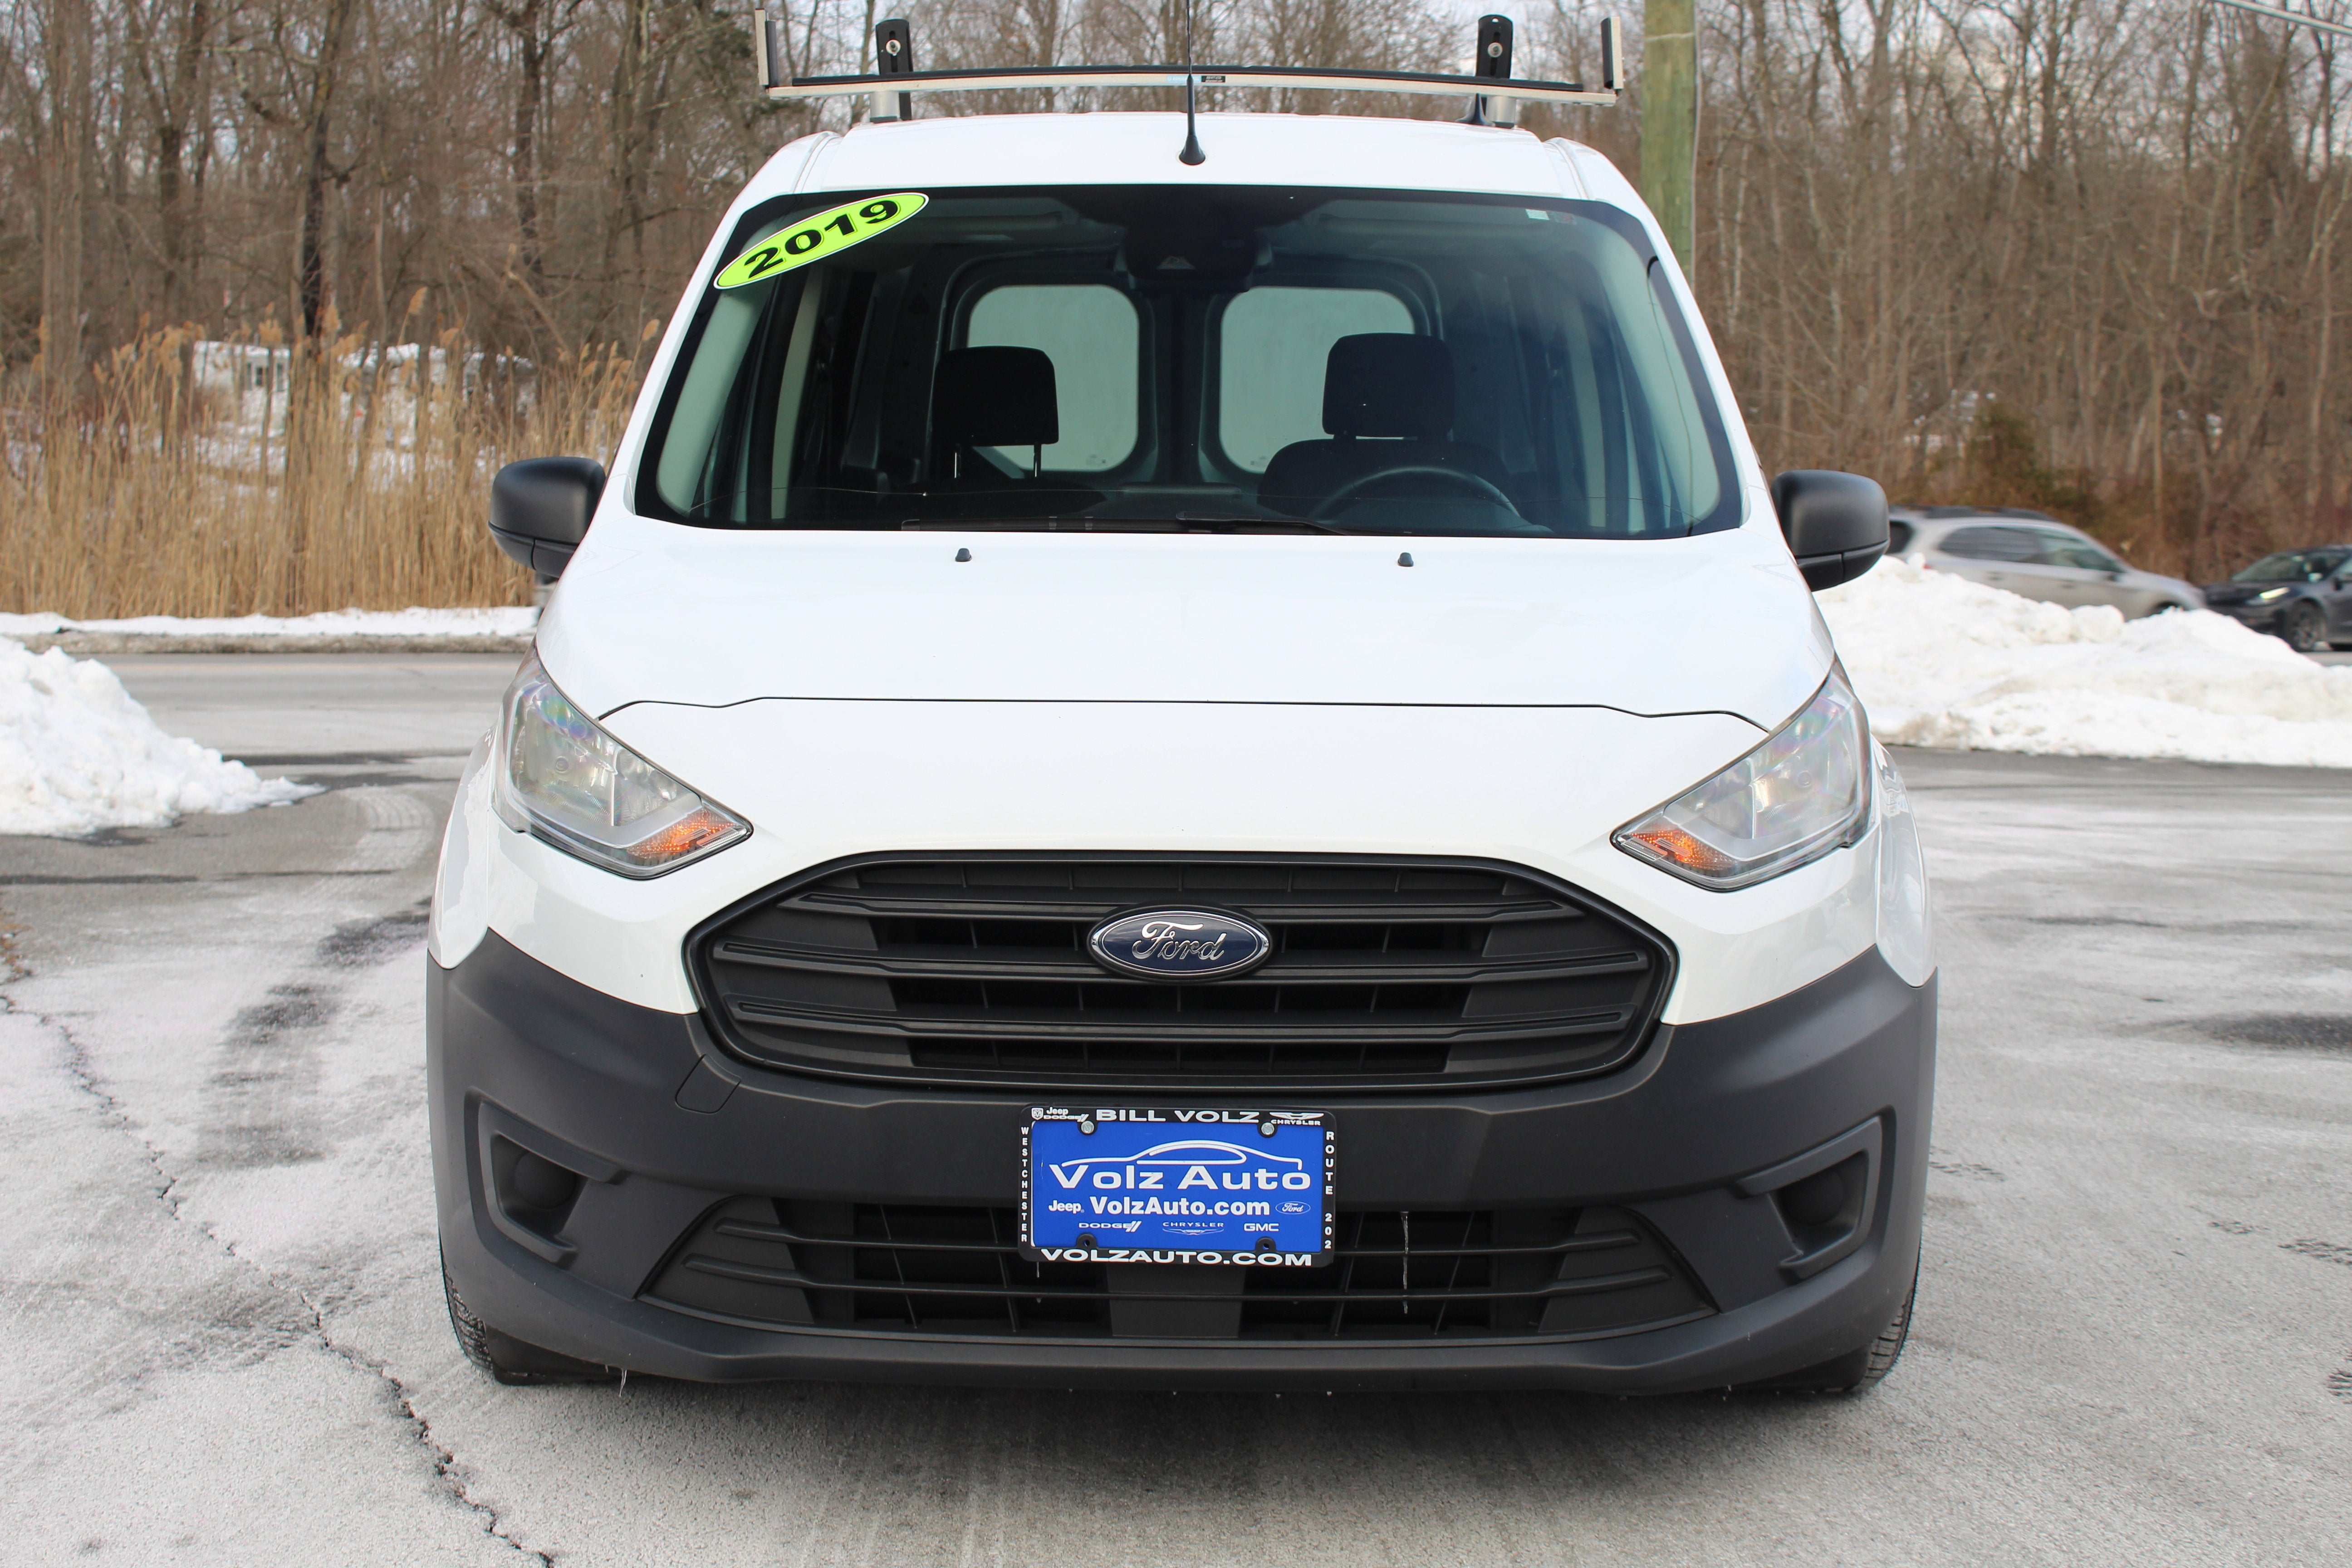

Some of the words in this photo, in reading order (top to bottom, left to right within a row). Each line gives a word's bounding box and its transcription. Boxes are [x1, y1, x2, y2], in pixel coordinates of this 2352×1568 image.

[744, 200, 901, 279] 2019
[1132, 921, 1227, 960] Ford
[1046, 1107, 1068, 1116] Jeep
[1096, 1109, 1166, 1122] BILL
[1174, 1110, 1259, 1123] VOLZ
[1325, 1131, 1335, 1195] ROUTE
[1020, 1127, 1029, 1242] WESTCHESTER
[1049, 1164, 1164, 1190] Volz
[1177, 1166, 1311, 1190] Auto
[1089, 1196, 1270, 1216] VolzAuto.com
[1282, 1203, 1304, 1213] Ford
[1244, 1223, 1279, 1231] GMC
[1324, 1213, 1333, 1250] 202
[1041, 1249, 1312, 1266] VOLZAUTO.COM
